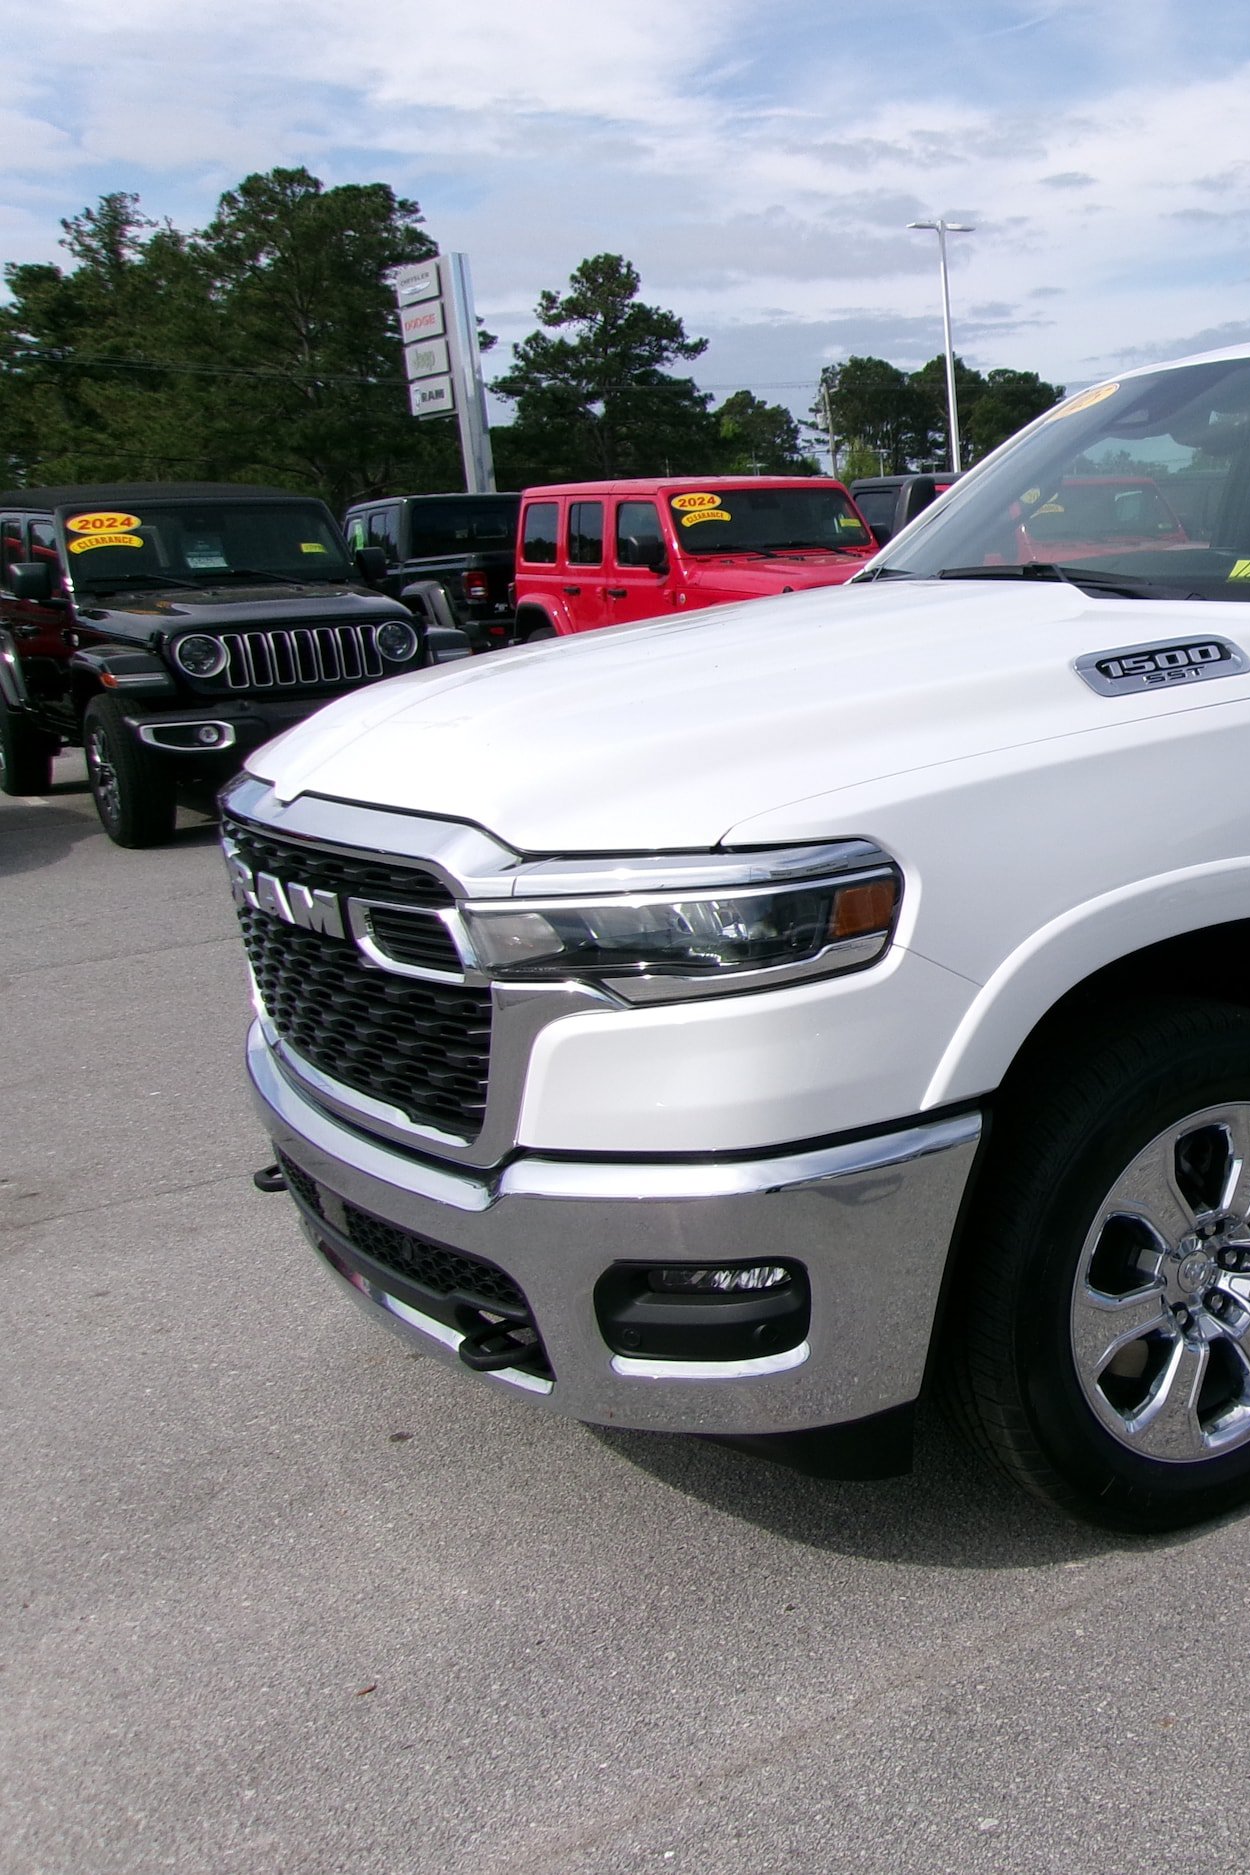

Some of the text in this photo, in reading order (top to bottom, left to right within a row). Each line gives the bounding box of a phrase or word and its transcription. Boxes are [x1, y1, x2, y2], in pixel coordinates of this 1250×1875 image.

[400, 271, 430, 287] CHRYSLER
[404, 313, 436, 332] DODGE
[421, 388, 444, 403] RAM
[678, 496, 717, 508] 2024
[78, 516, 134, 530] 2024
[686, 511, 724, 524] CLEARANCE
[77, 535, 134, 549] CLEARANCE
[1101, 645, 1221, 678] 1500
[1142, 665, 1207, 685] SST
[223, 837, 346, 939] RAM
